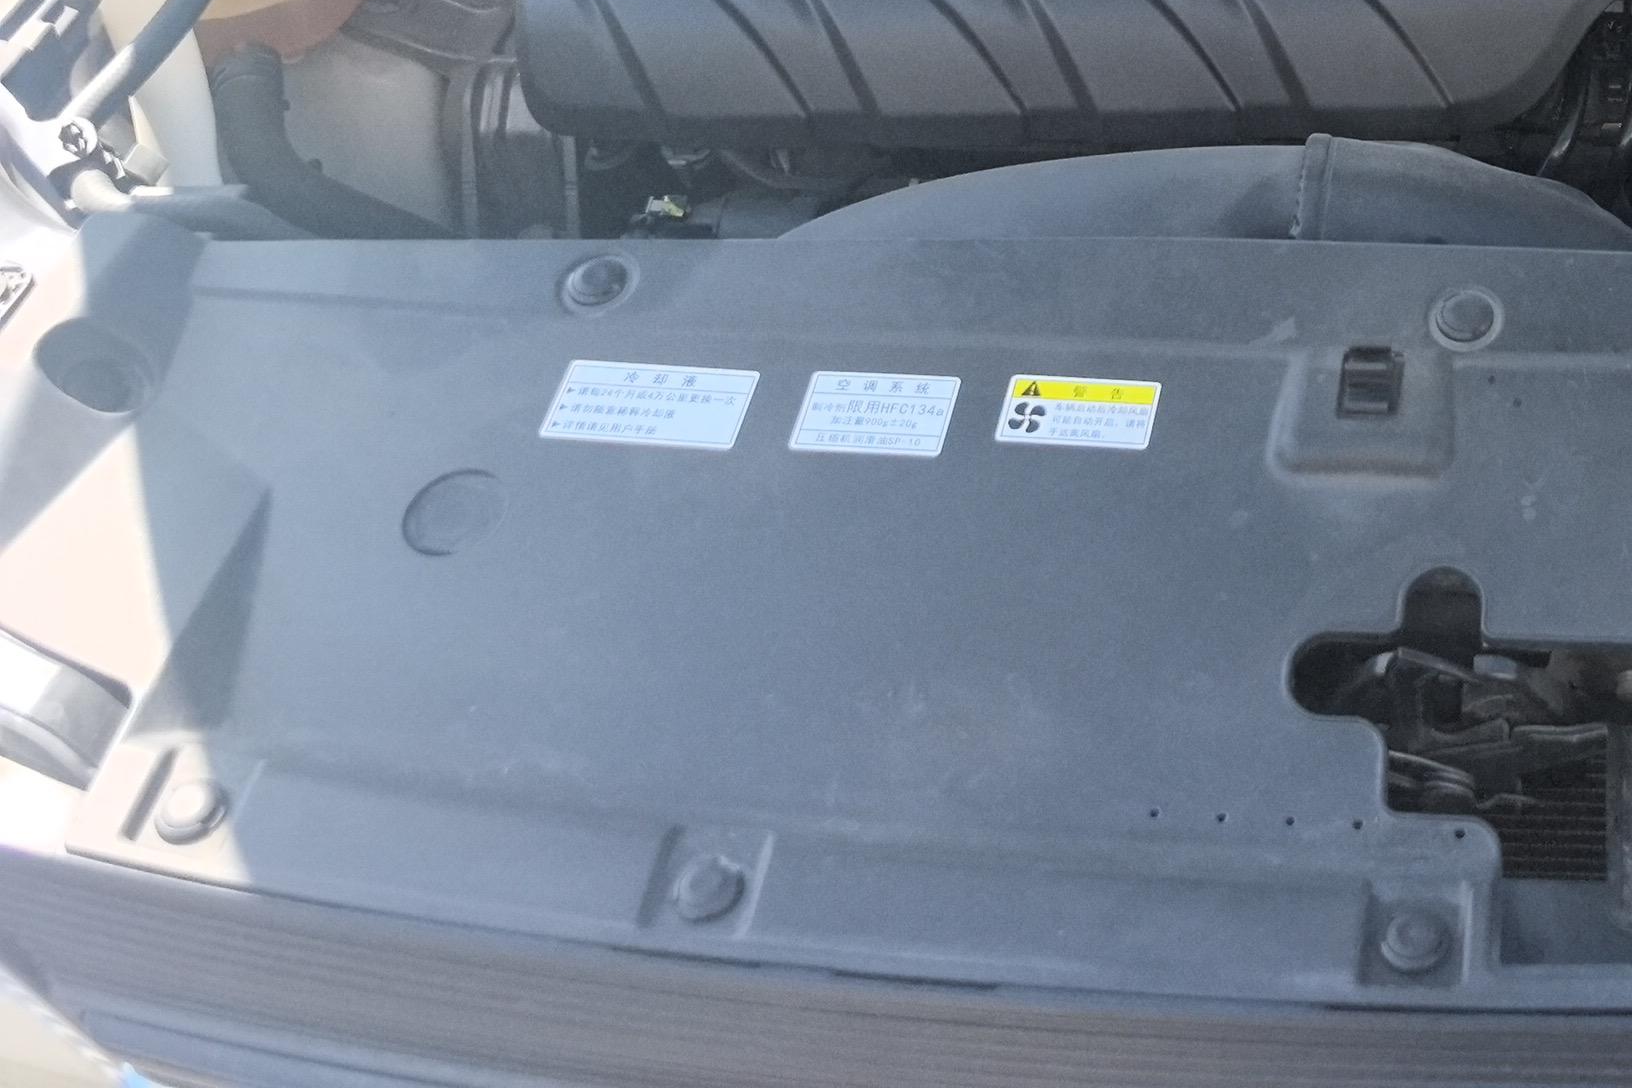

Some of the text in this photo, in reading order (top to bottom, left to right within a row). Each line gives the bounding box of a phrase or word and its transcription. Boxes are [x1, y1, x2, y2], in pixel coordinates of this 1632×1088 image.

[623, 371, 698, 388] 冷却液
[835, 378, 930, 395] 空调系统
